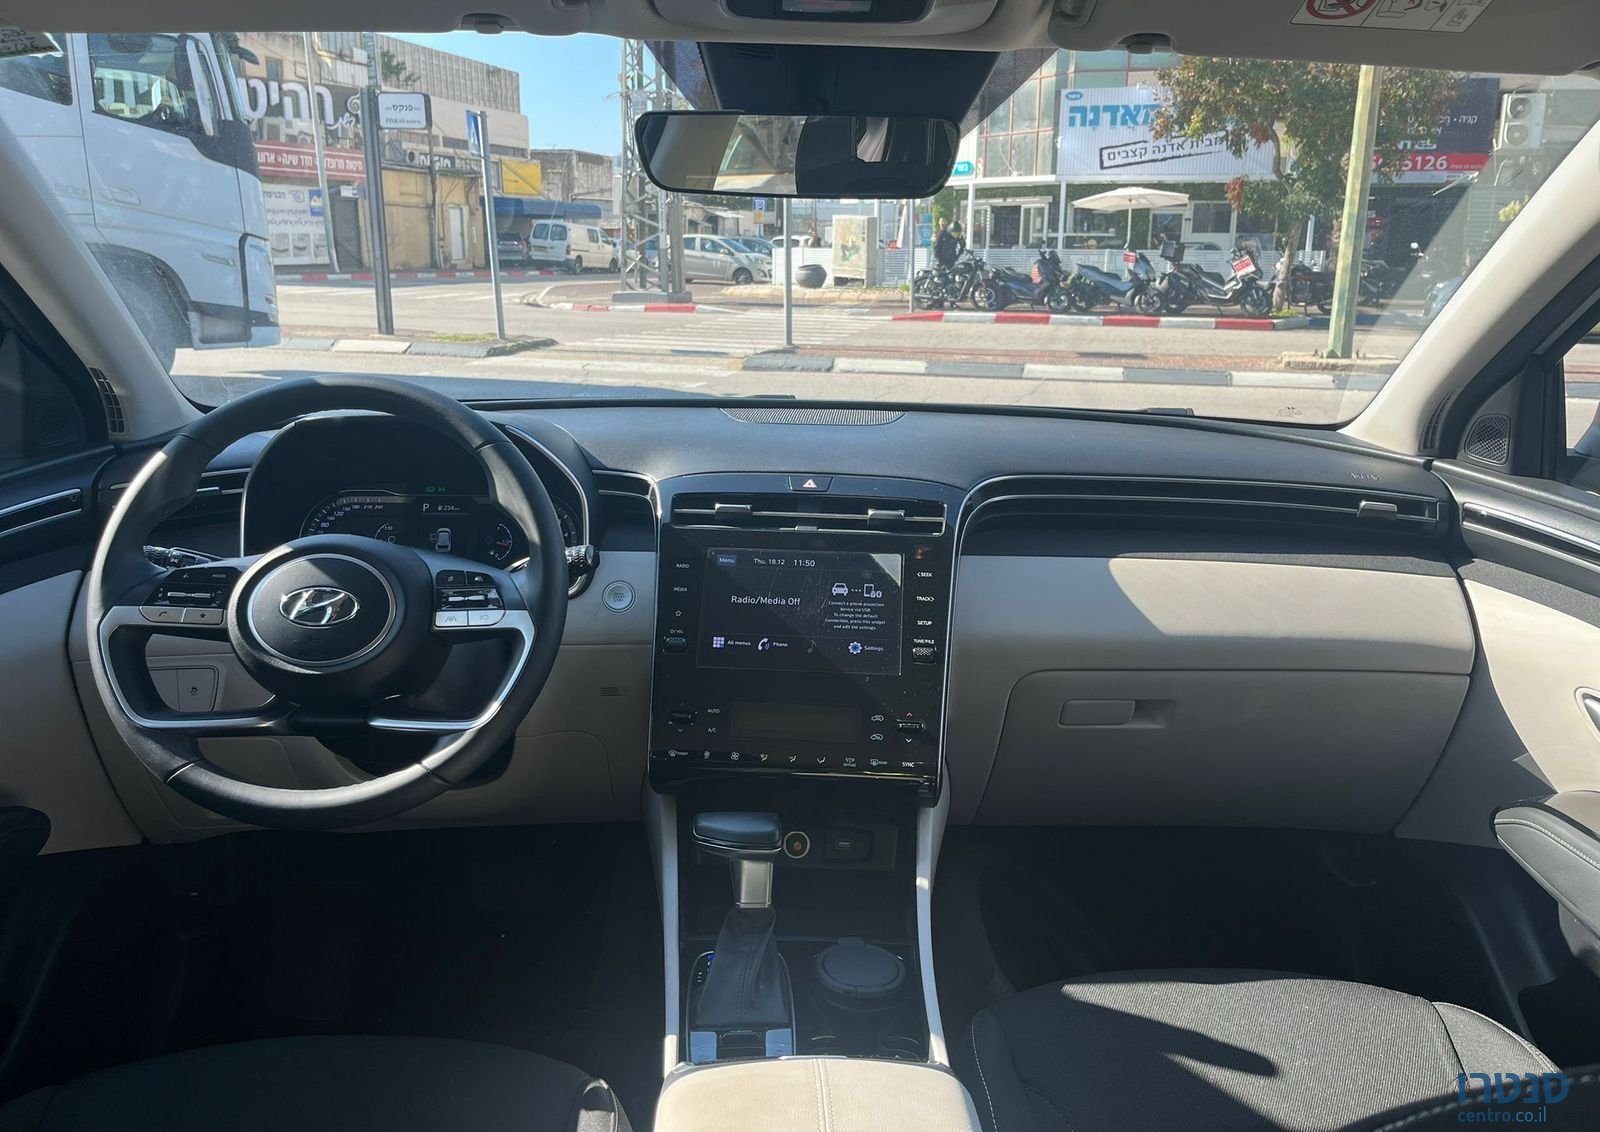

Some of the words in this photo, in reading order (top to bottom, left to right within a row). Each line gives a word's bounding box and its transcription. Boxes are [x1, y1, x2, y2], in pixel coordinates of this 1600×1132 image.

[1108, 147, 1148, 161] קצבים
[1152, 142, 1184, 155] אדנה
[423, 504, 429, 512] P
[731, 595, 786, 605] Radio/Media
[788, 597, 801, 606] Off
